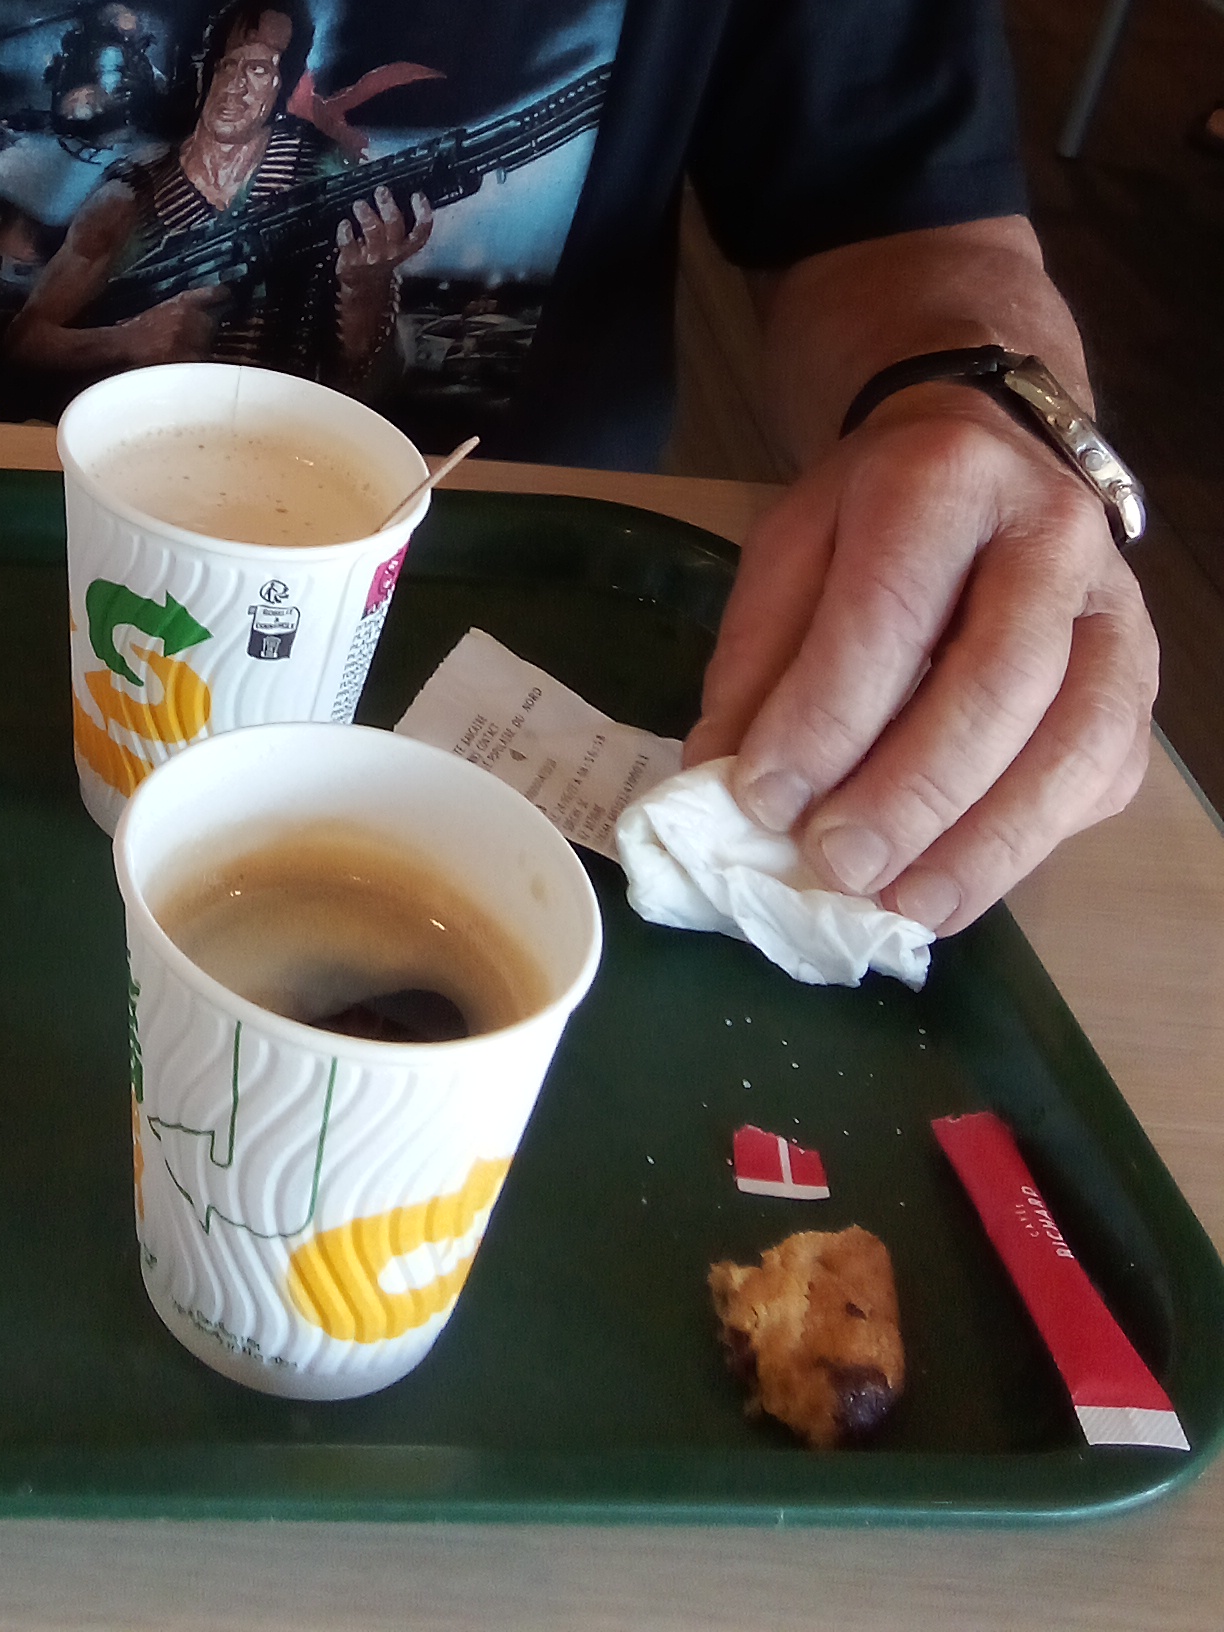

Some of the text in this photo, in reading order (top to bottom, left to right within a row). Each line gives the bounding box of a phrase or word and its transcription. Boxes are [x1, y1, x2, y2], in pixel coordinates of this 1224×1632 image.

[511, 713, 526, 729] DU
[521, 686, 543, 713] NORD
[476, 722, 499, 752] CONTACT
[1020, 1185, 1075, 1260] RICHARD
